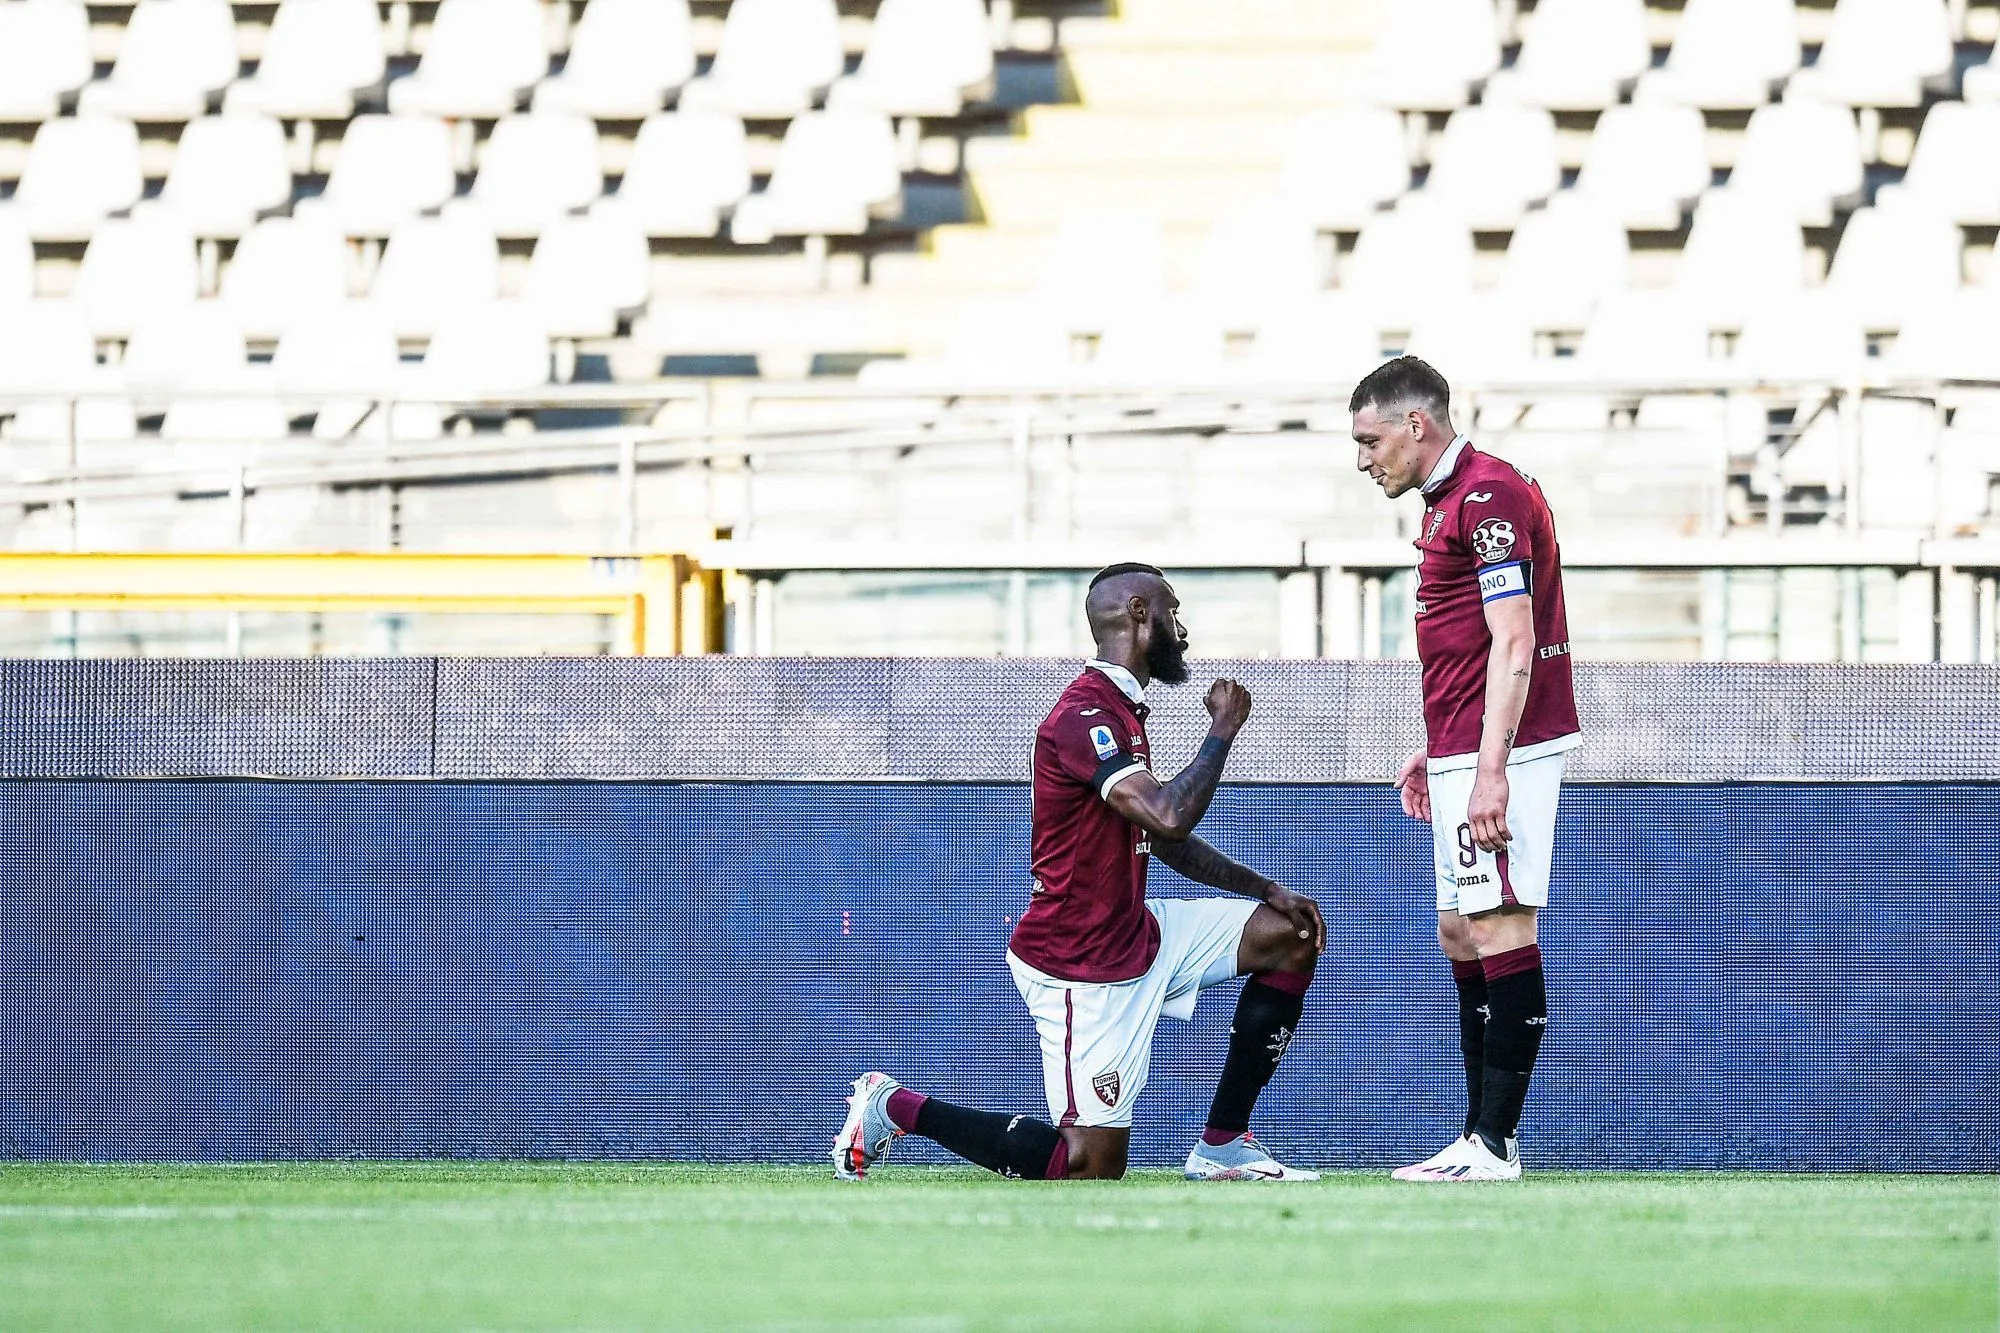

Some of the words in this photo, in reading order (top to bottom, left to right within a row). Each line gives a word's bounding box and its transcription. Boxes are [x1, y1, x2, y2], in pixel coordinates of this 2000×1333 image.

[1472, 521, 1516, 554] 38
[1457, 822, 1477, 868] 9
[1096, 1074, 1117, 1086] TORINO
